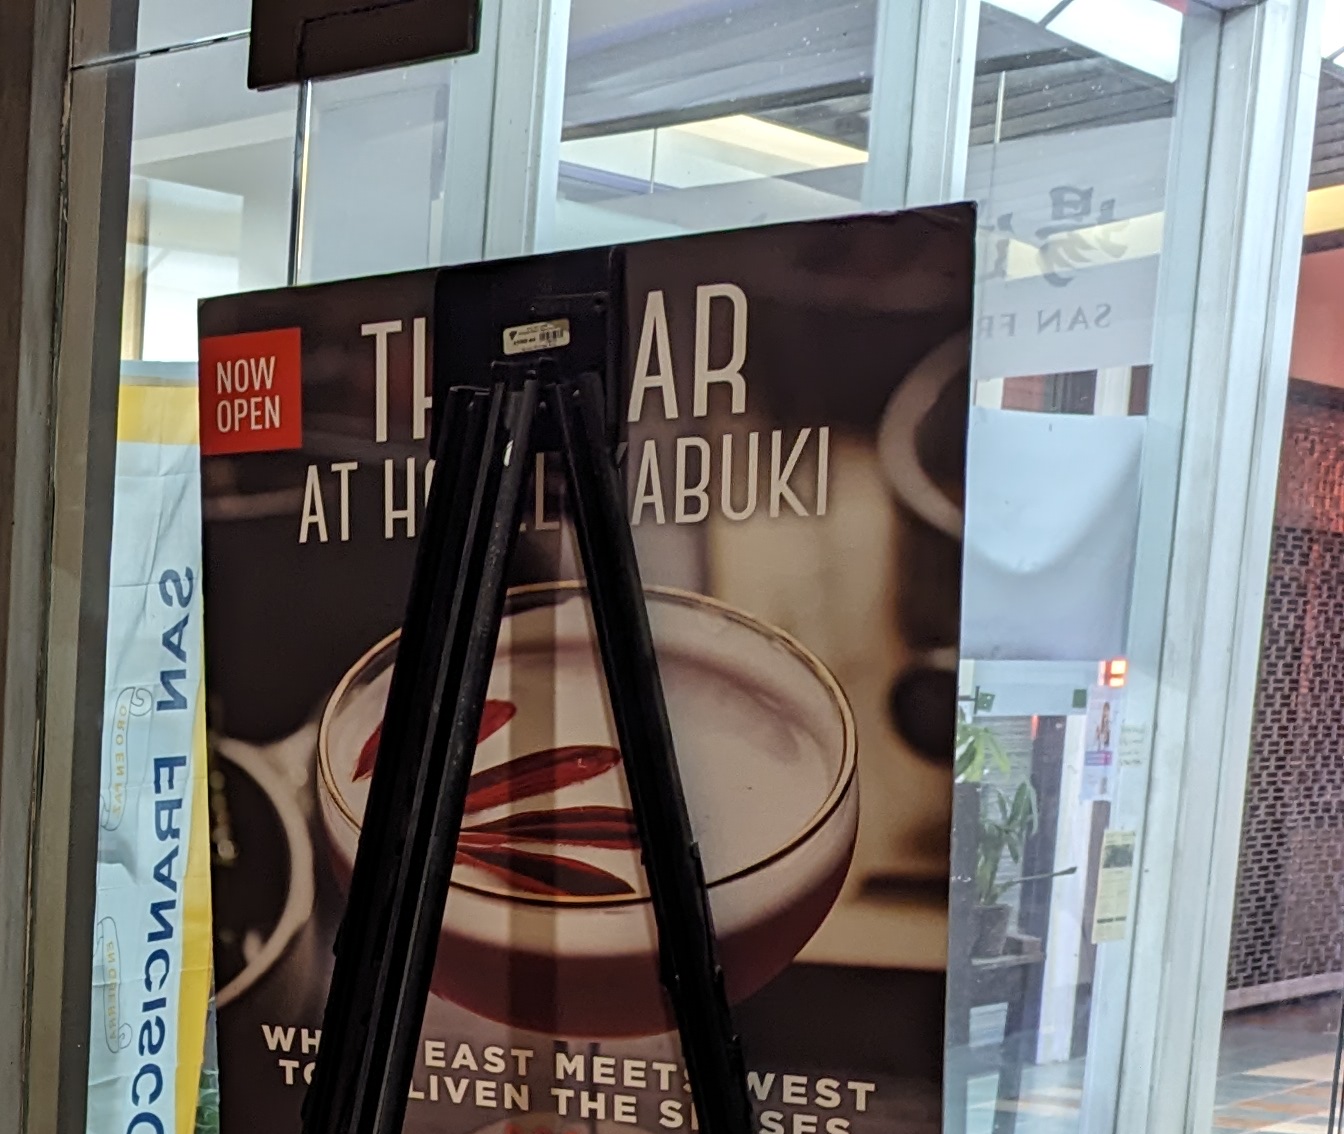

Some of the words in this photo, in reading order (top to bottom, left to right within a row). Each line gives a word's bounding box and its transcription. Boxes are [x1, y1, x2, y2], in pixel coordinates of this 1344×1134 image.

[215, 355, 277, 394] NOW
[627, 283, 749, 423] AR
[216, 395, 281, 433] OPEN
[298, 460, 359, 544] AT
[615, 426, 831, 527] ABUKI
[424, 1039, 534, 1077] EAST
[408, 1074, 531, 1112] LIVEN
[551, 1087, 638, 1124] THE
